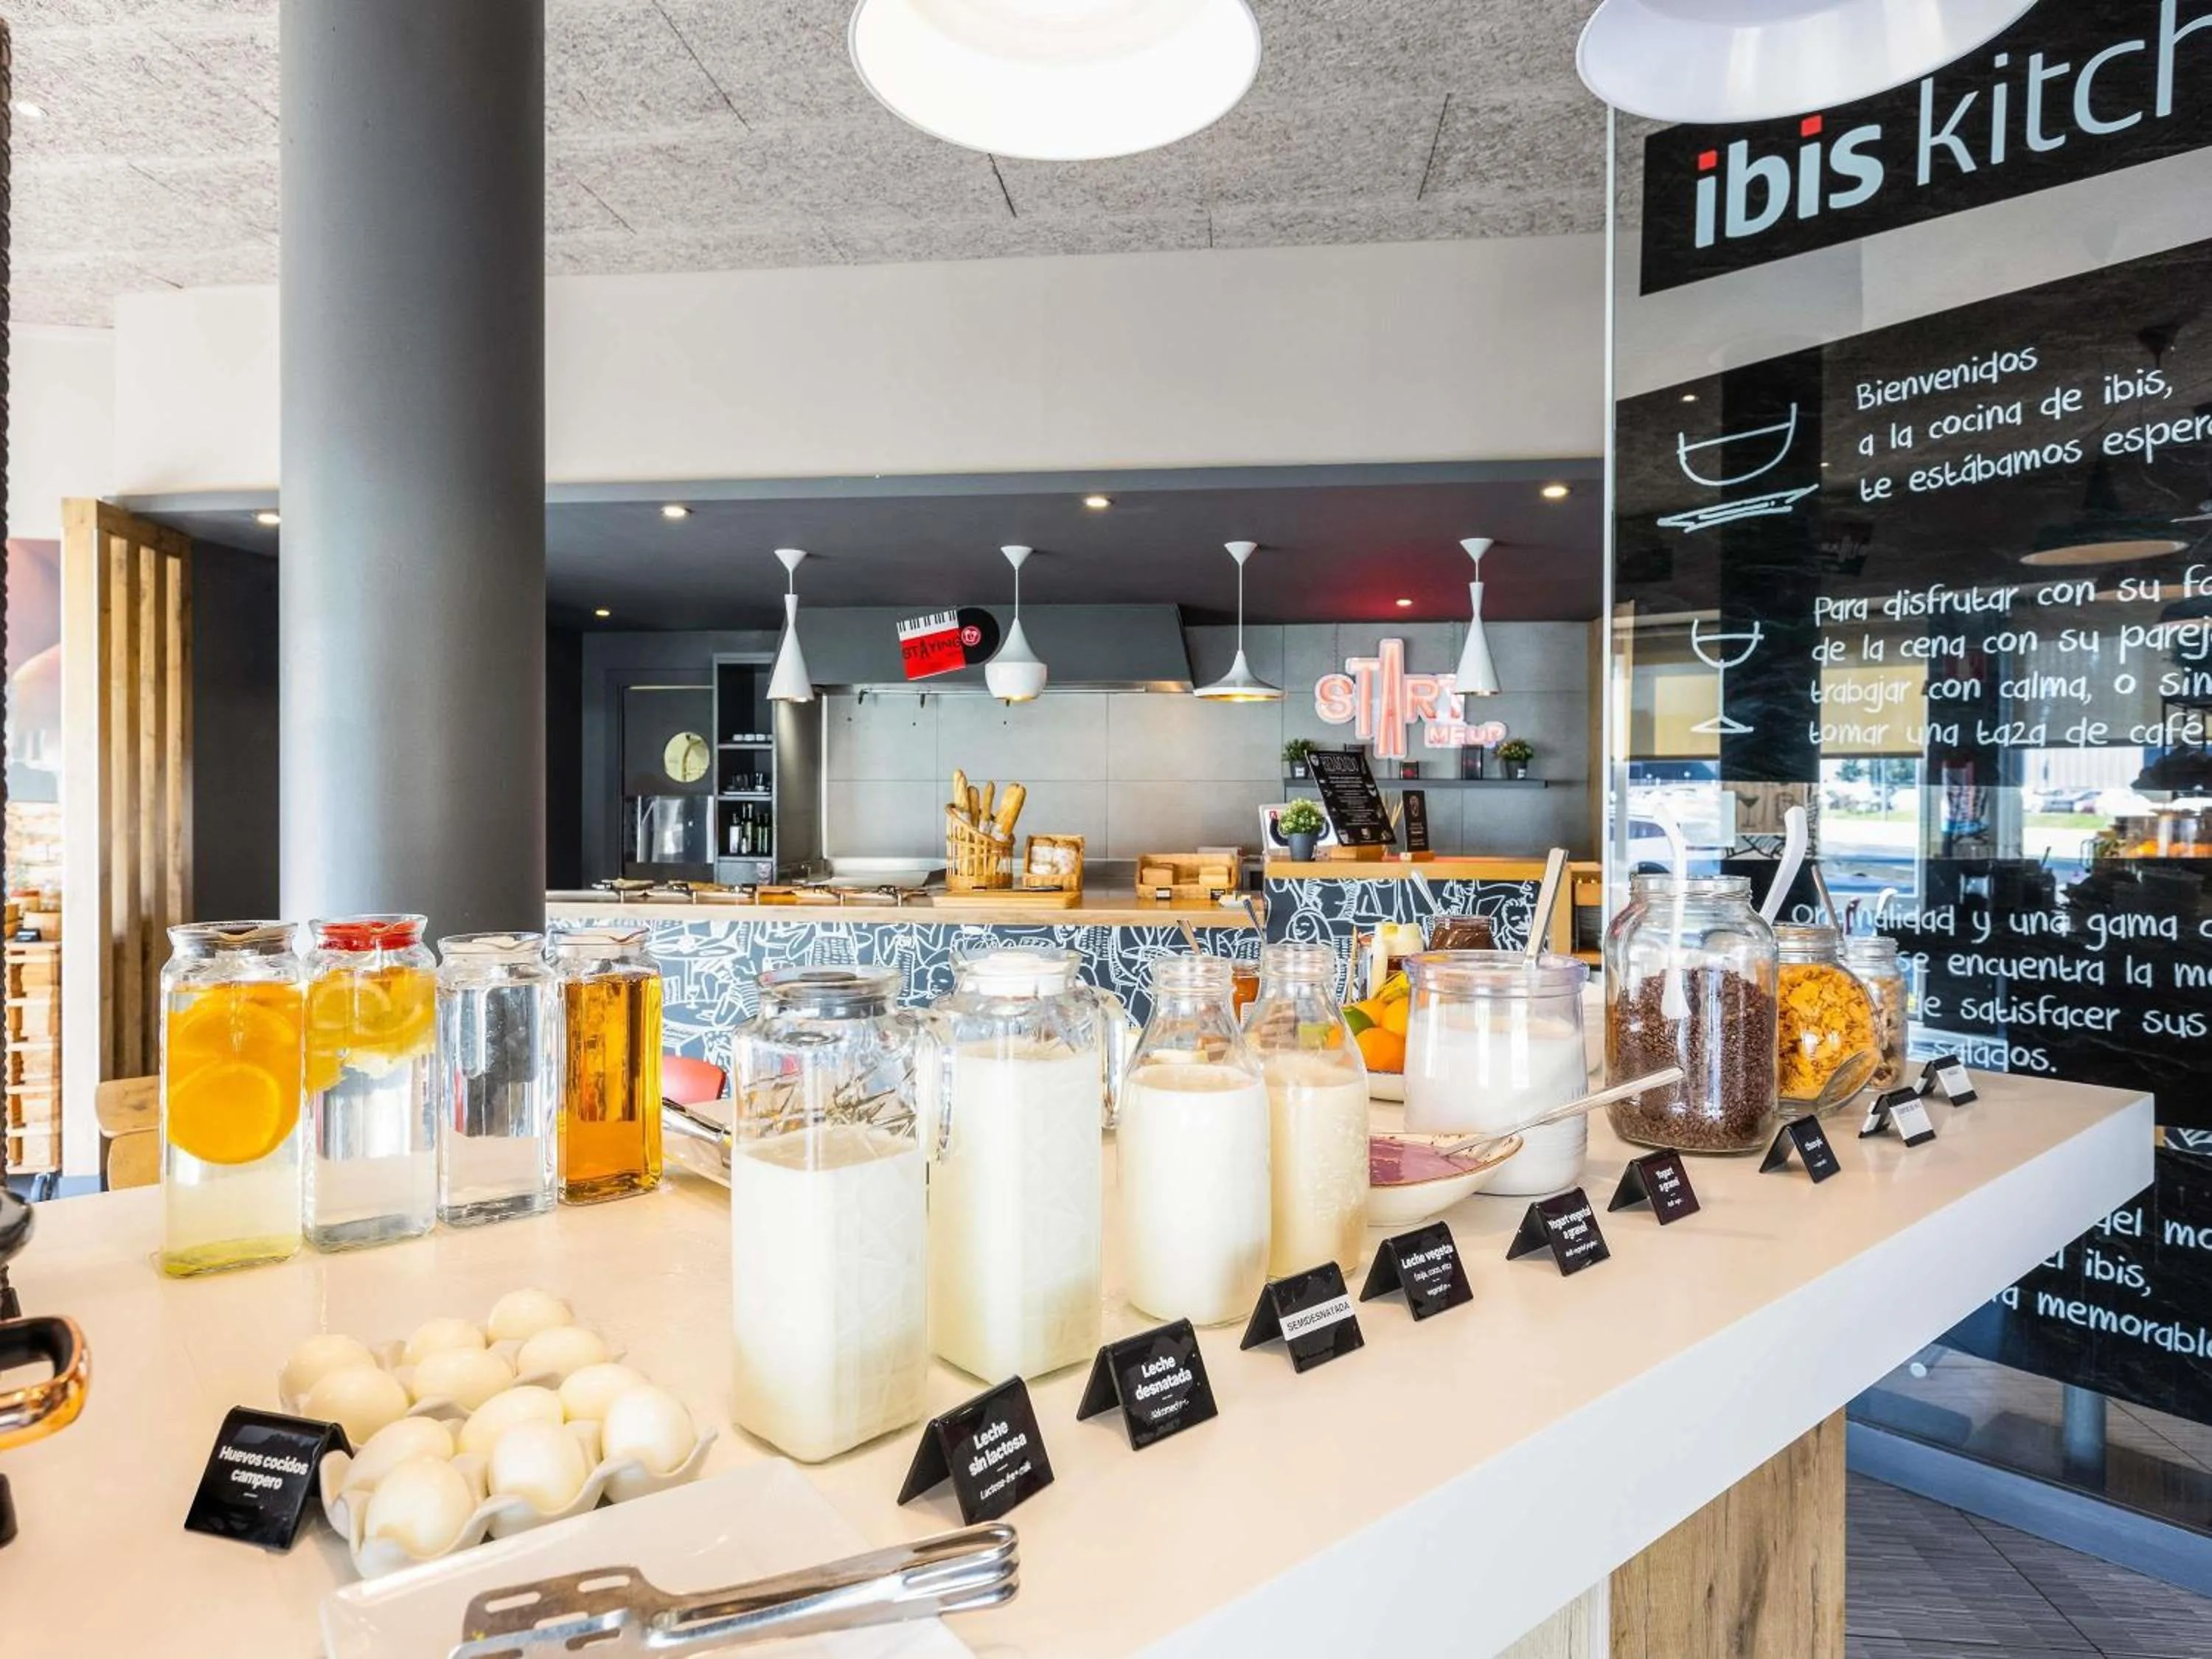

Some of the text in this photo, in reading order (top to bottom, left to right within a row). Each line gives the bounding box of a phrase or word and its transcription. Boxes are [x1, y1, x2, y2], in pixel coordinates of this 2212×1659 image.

[1695, 114, 1885, 249] ibis
[1856, 347, 2039, 411] Bienvenidos
[1859, 369, 2174, 456] a la cocina de ibis,
[1860, 415, 2212, 502] te estábamos esper
[1815, 595, 1868, 627] Para
[1882, 584, 2020, 621] disfrutar
[2037, 579, 2096, 606] con
[2117, 577, 2161, 602] su
[1811, 615, 2212, 666] de la cena con su parej
[1810, 676, 1913, 713] trabajar
[1927, 678, 1981, 701] con
[1999, 671, 2093, 705] calma,
[2114, 672, 2136, 696] o
[1429, 723, 1505, 745] ME UP
[1809, 720, 1889, 746] tomar
[1907, 721, 1959, 748] una
[2066, 717, 2109, 750] de
[1972, 908, 1991, 944] y
[2084, 912, 2177, 951] gama
[1947, 953, 2104, 986] encuentra
[2126, 955, 2152, 988] la
[1960, 995, 2121, 1032] satisfacer
[2142, 1009, 2207, 1038] sus
[2084, 1248, 2152, 1298] ibis,
[2037, 1290, 2212, 1358] memorabl
[1135, 1368, 1192, 1401] desnatada
[1141, 1355, 1175, 1378] Leche
[968, 1432, 1027, 1477] sin lactosa
[973, 1420, 1009, 1450] Leche
[219, 1445, 308, 1475] Huevos cocidos
[231, 1468, 283, 1490] campero
